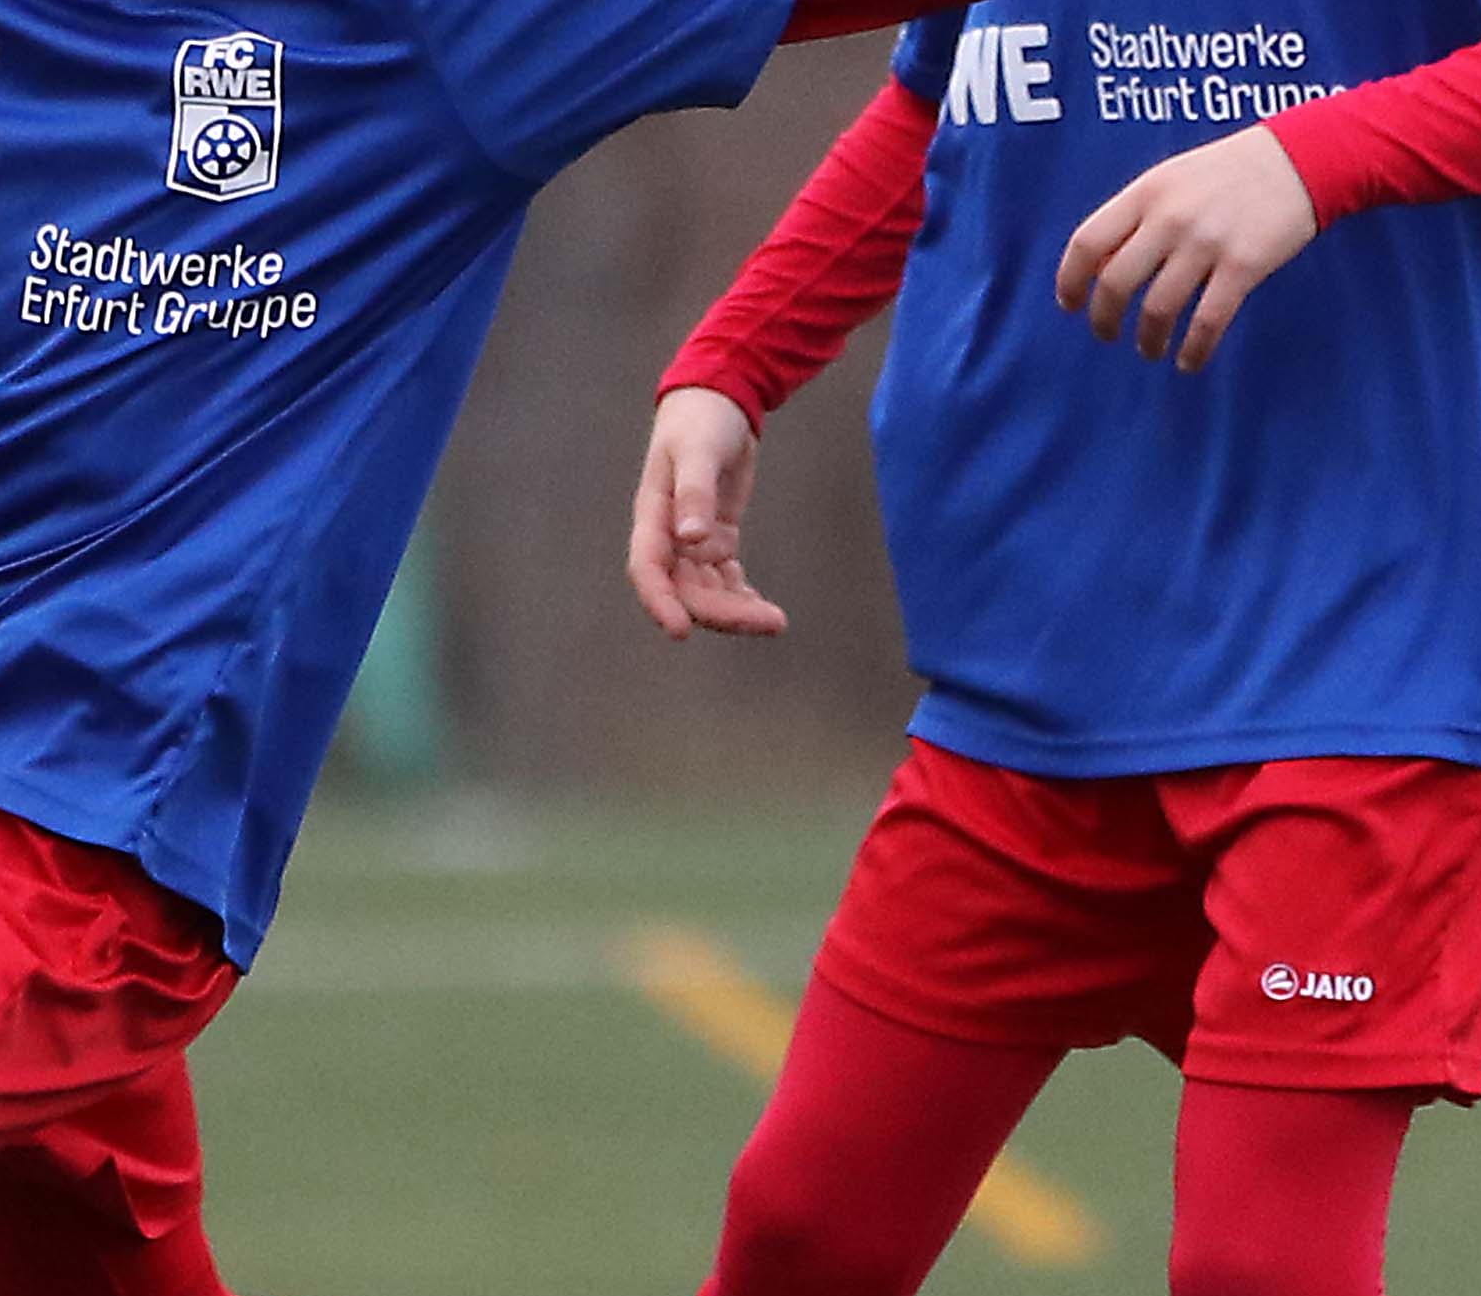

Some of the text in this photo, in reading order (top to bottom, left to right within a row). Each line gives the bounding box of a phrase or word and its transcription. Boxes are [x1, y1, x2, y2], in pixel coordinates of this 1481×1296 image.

[202, 38, 255, 70] FC
[1089, 22, 1306, 70] Stadtwerke
[183, 67, 271, 101] RWE
[947, 23, 1062, 126] WE
[1097, 75, 1199, 123] Erfurt
[30, 223, 285, 289] Stadtwerke
[20, 276, 317, 339] Erfurt Gruppe
[1298, 972, 1375, 1002] JAKO
